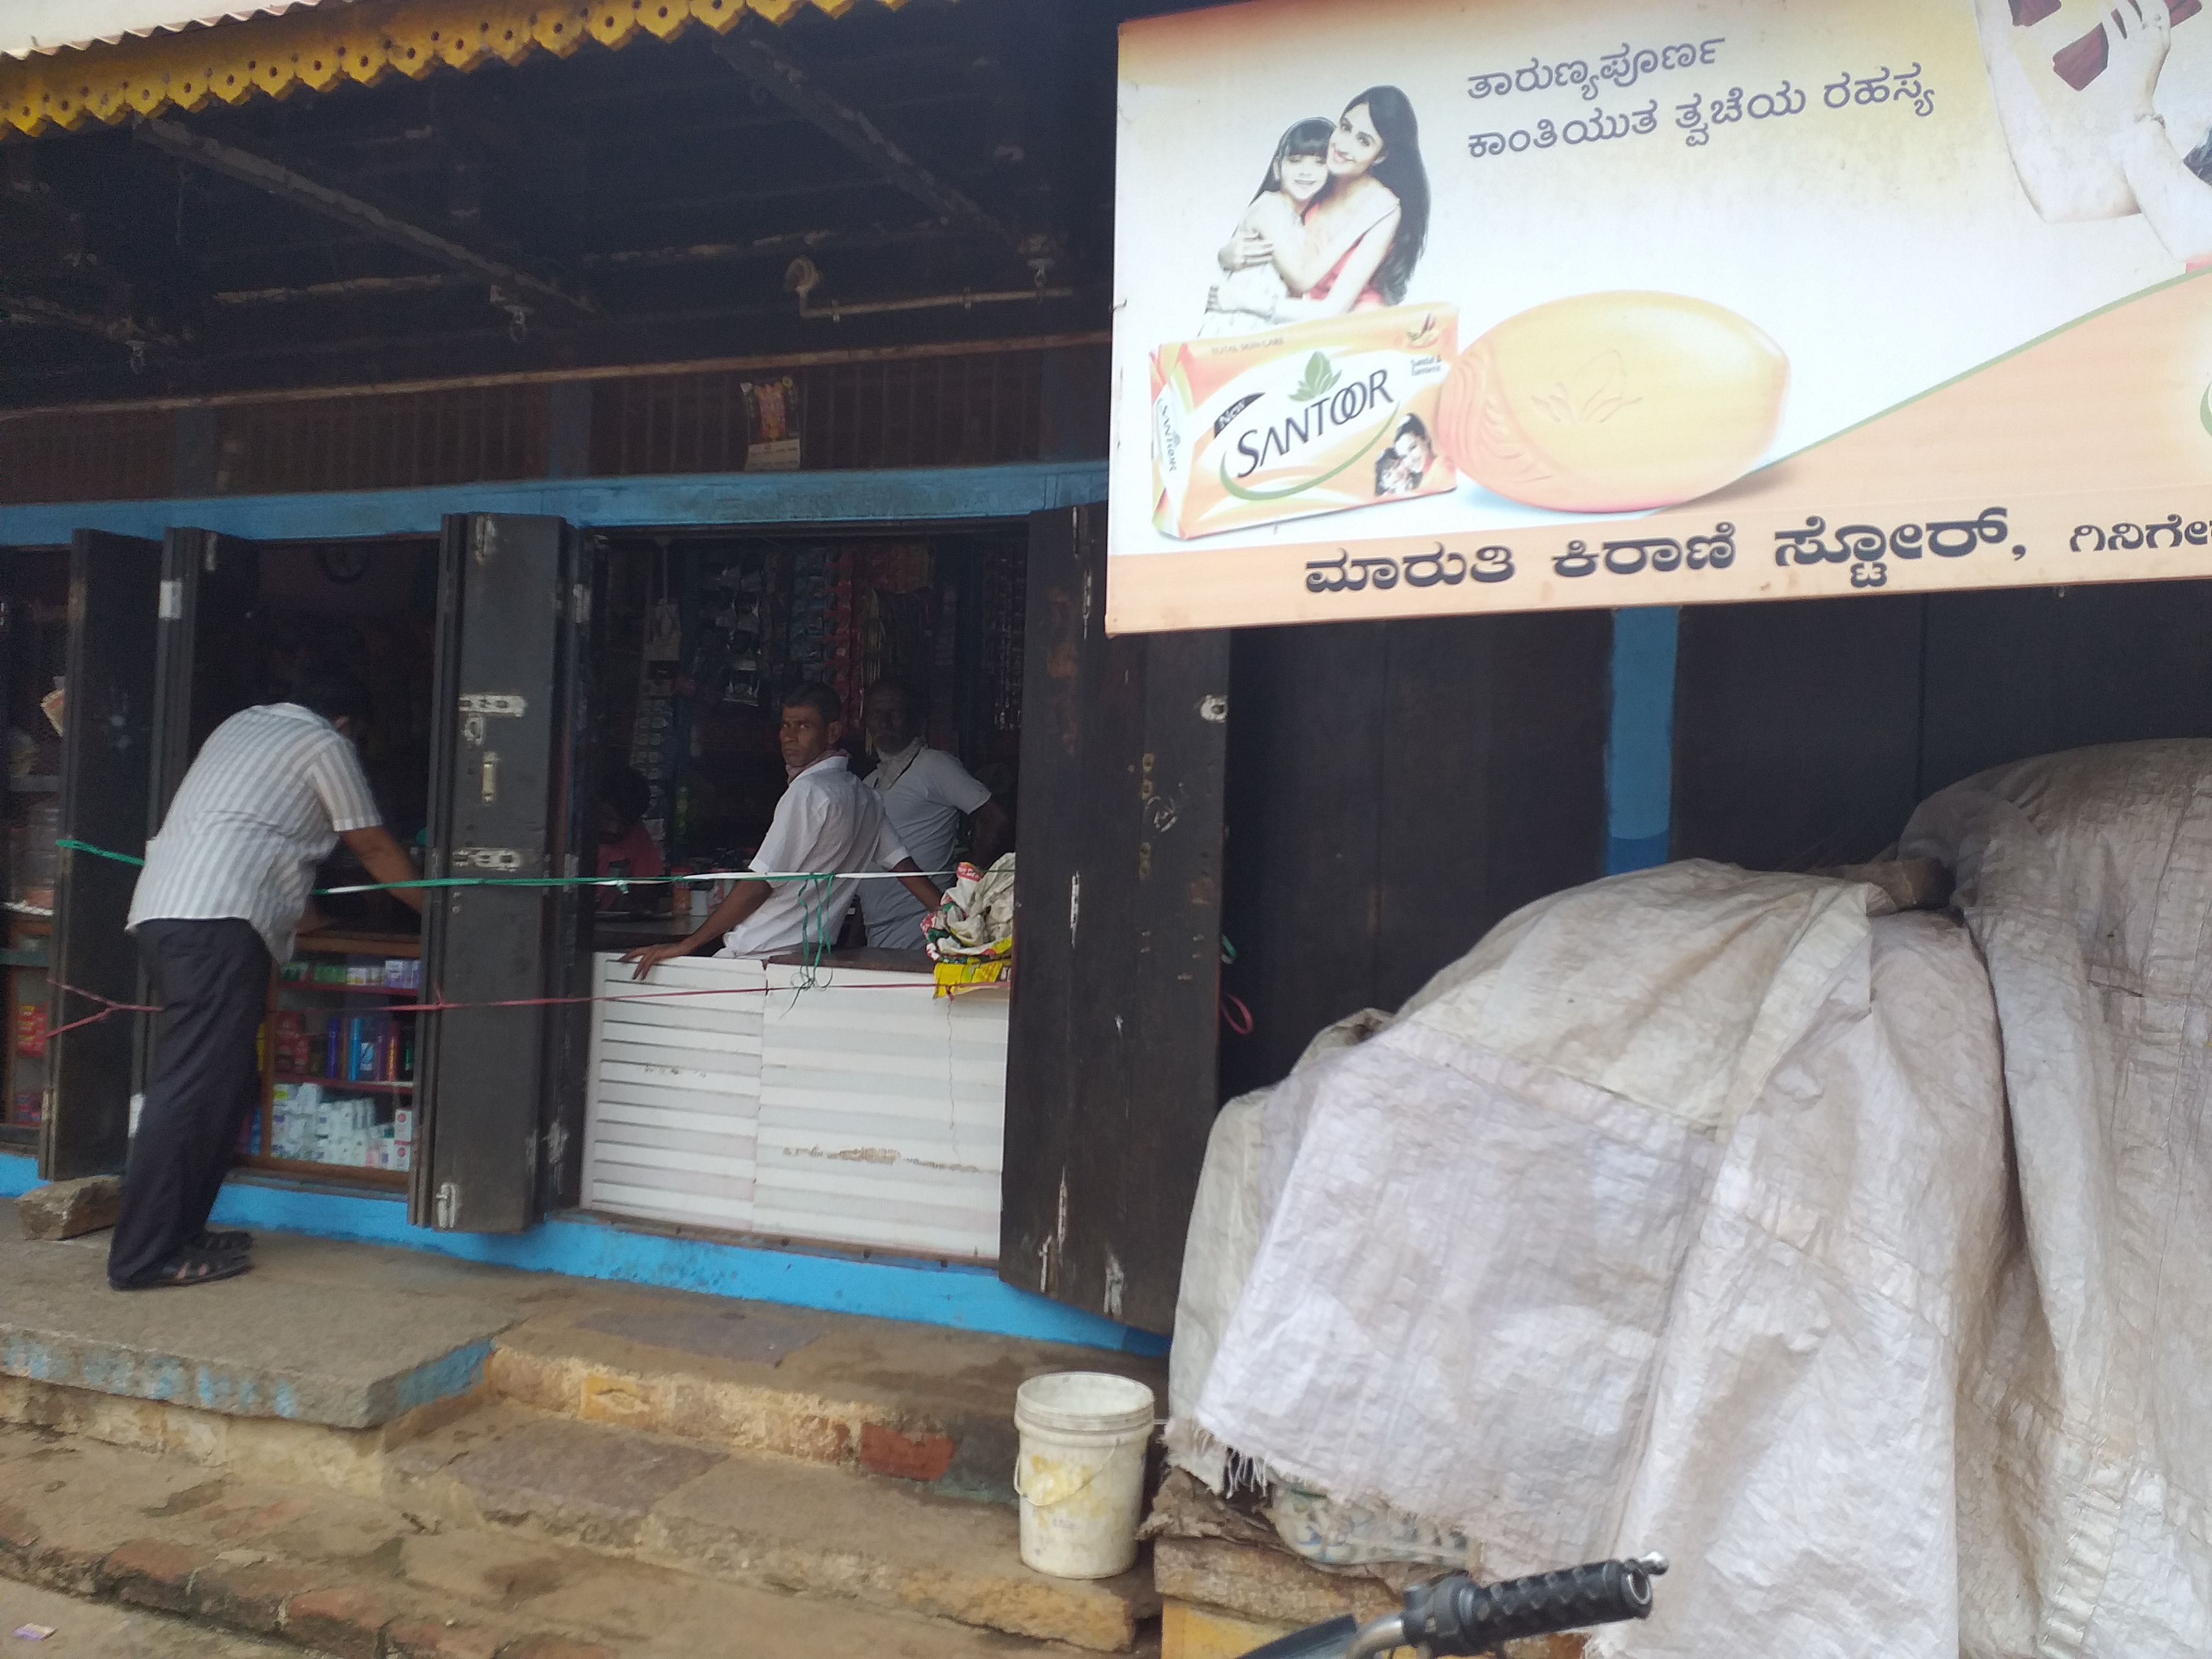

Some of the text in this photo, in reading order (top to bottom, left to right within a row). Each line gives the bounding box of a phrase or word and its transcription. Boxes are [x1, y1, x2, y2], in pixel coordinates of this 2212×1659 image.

[1467, 38, 1725, 100] ತಾರುಣ್ಯಪೂರ್ಣ
[1468, 62, 1935, 158] ಕಾಂತಿಯುತ ತ್ವಚೆಯ ರಹಸ್ಯ
[1237, 368, 1394, 478] SANTOOR
[1305, 506, 2212, 593] ಮಾರುತಿ ಕಿರಾಣಿ ಸ್ಟೋರ್, ಗಿನಿಗೇ
